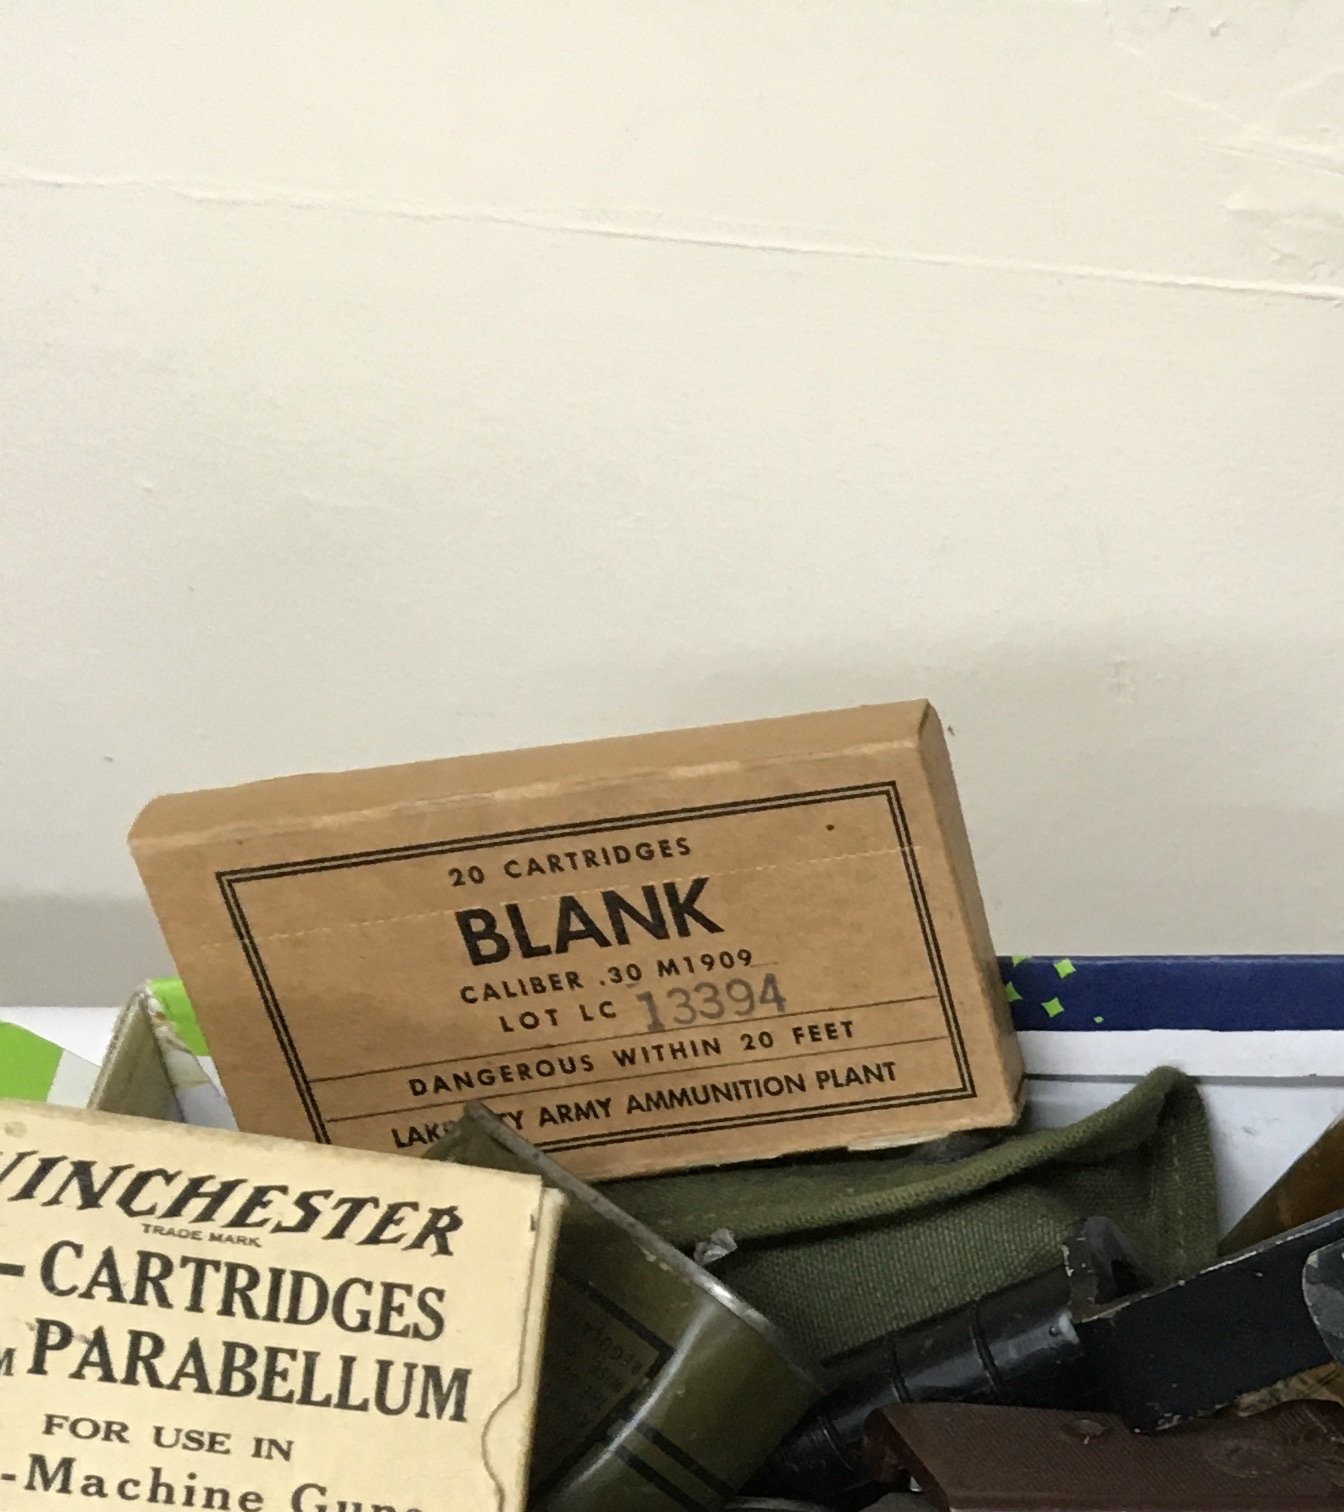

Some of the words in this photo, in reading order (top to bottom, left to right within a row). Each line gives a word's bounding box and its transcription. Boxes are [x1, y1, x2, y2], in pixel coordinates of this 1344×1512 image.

[448, 866, 485, 887] 20
[504, 836, 691, 879] CARTRIDGES
[455, 877, 724, 966] BLANK
[461, 971, 583, 1004] CALIBER
[600, 963, 642, 986] .30
[657, 949, 752, 979] M1909
[499, 1008, 557, 1032] LOT
[580, 1001, 616, 1022] LC
[635, 972, 786, 1032] 13394
[408, 1055, 594, 1096] DANGEROUS
[612, 1037, 721, 1068] WITHIN
[740, 1031, 774, 1051] 20
[792, 1020, 854, 1044] FEET
[539, 1098, 612, 1127] ARMY
[626, 1073, 806, 1114] AMMUNITION
[815, 1061, 896, 1090] PLANT
[142, 1223, 202, 1240] TRADE
[208, 1232, 262, 1248] MARK
[27, 1317, 473, 1423] PARABELLUM
[42, 1413, 130, 1443] FOR
[153, 1425, 232, 1455] USE
[251, 1437, 294, 1462] IN
